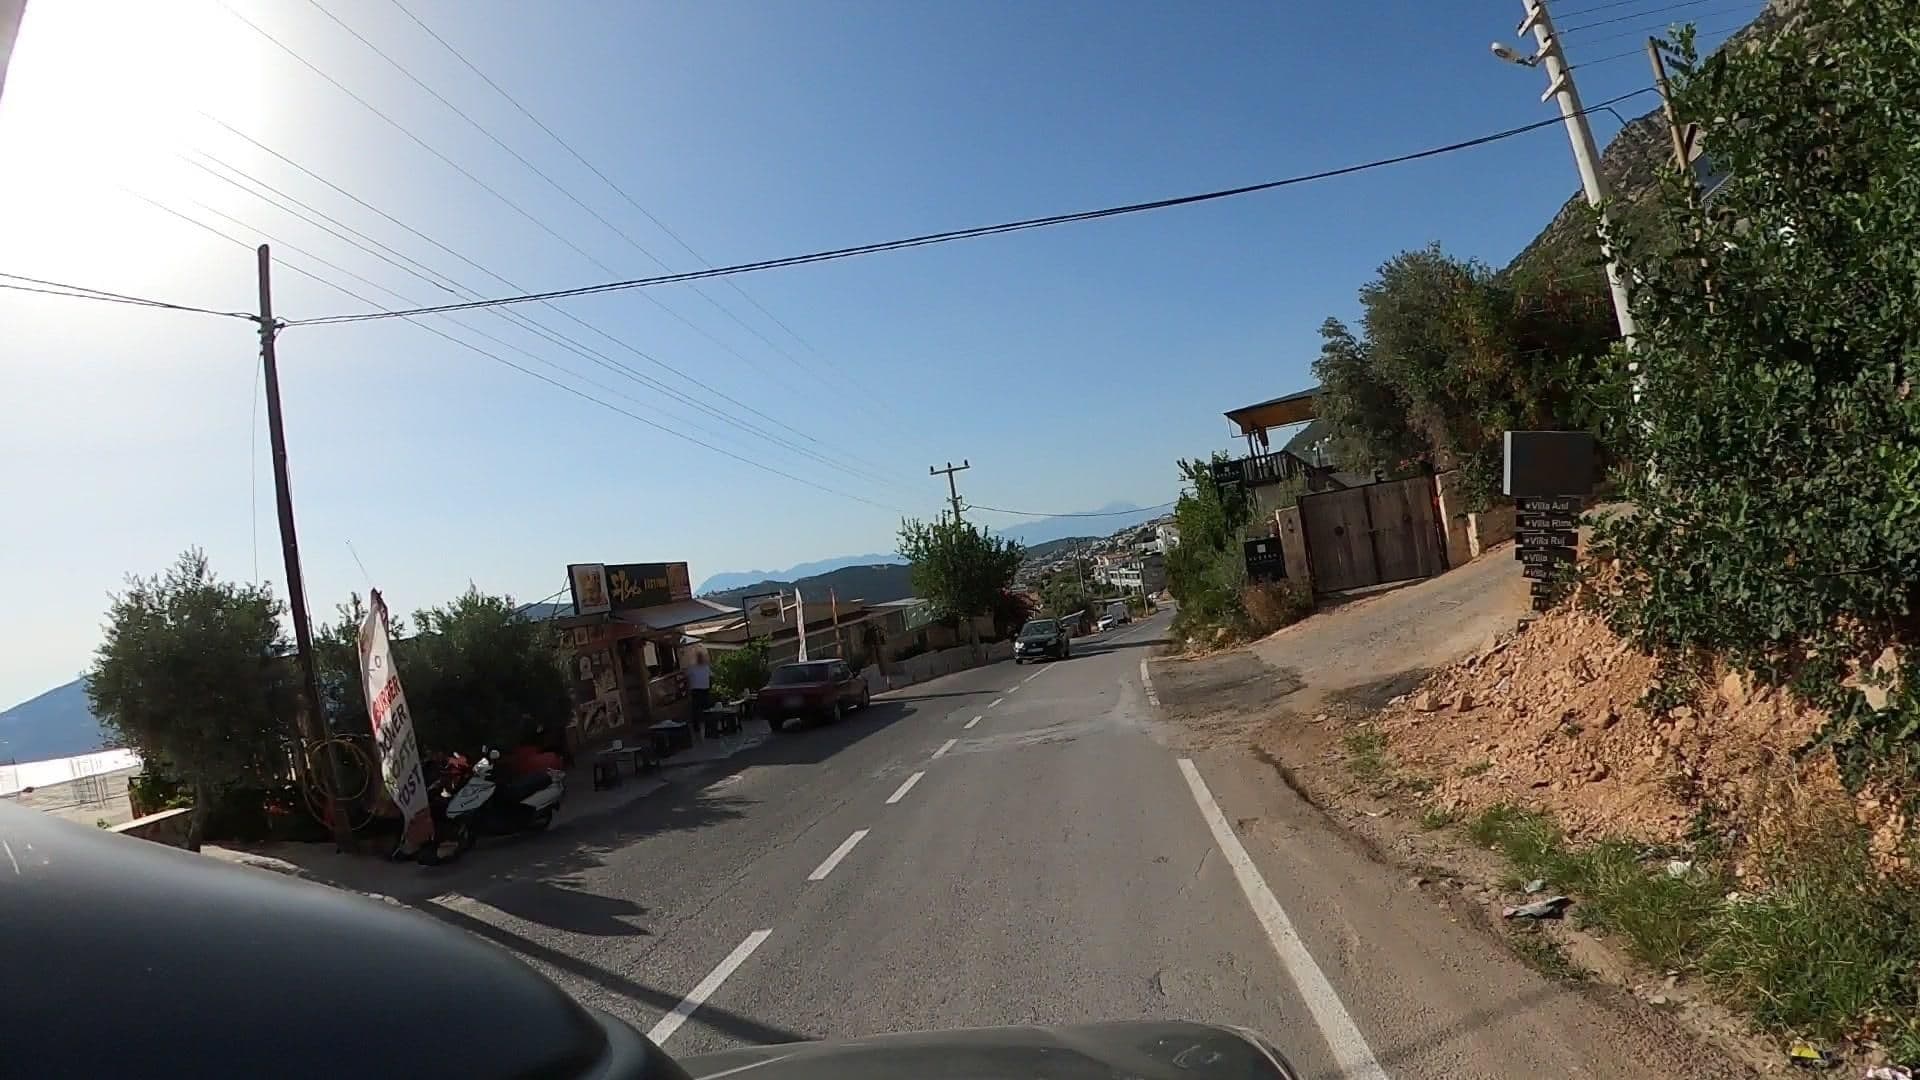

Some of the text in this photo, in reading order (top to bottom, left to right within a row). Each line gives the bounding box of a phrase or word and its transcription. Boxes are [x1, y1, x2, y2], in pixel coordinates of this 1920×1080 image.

[1532, 502, 1550, 511] Villa
[1532, 519, 1550, 528] Villa
[1530, 535, 1549, 545] Villa
[1529, 553, 1548, 562] Villa
